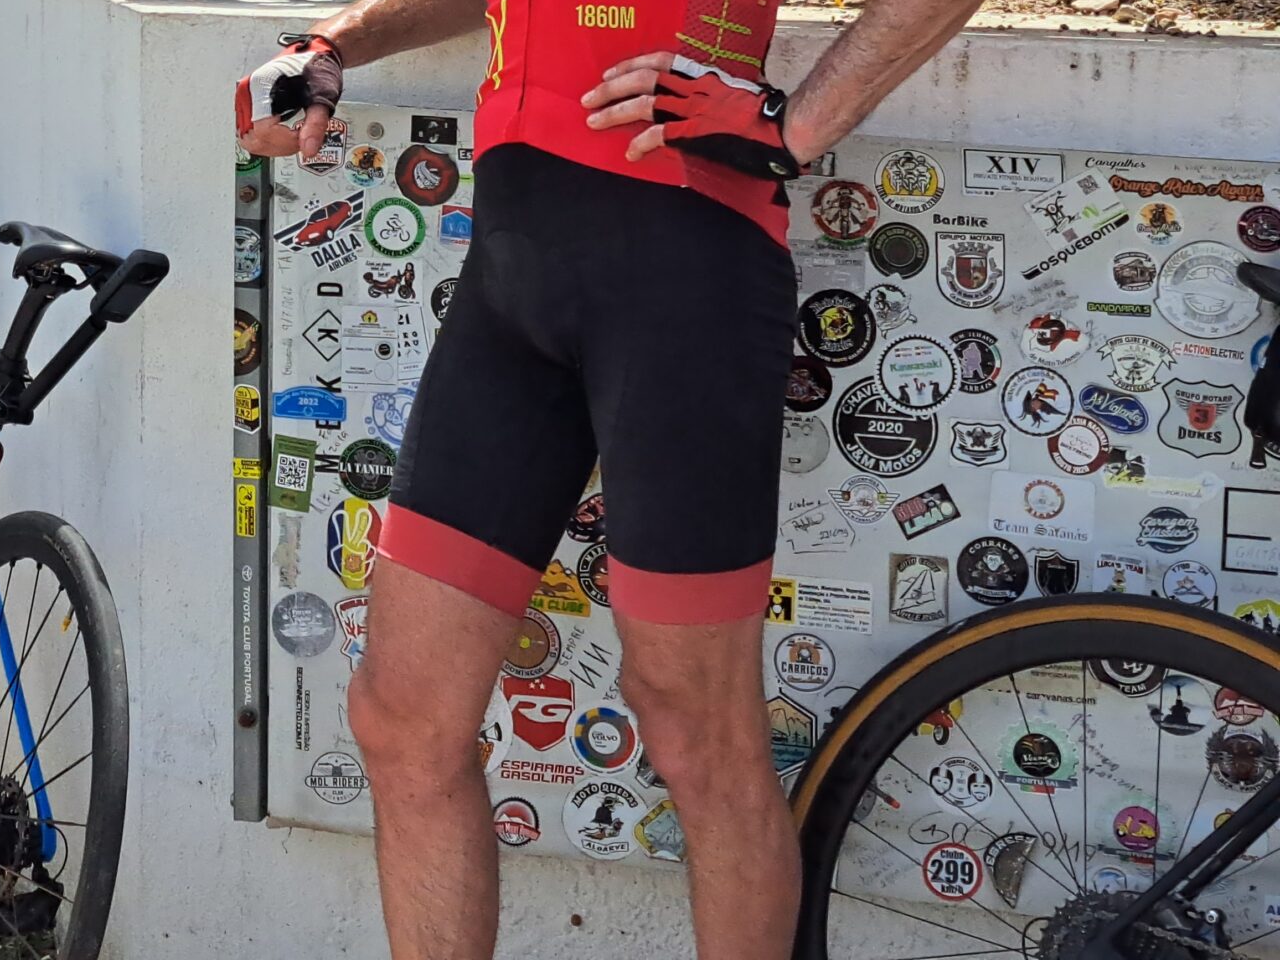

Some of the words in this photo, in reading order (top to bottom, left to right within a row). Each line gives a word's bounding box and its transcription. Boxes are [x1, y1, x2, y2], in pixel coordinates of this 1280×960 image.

[575, 4, 635, 29] 1860M
[987, 154, 1041, 175] XIV
[932, 213, 989, 228] BarBike
[310, 233, 362, 269] DALILA
[328, 252, 358, 273] AIRLINES
[1183, 343, 1245, 360] ACTIONELECTRIC
[889, 359, 943, 372] Kawasaki
[297, 397, 320, 406] 2022
[867, 420, 904, 435] 2020
[1177, 425, 1223, 444] DUKES
[845, 442, 876, 471] J&M
[878, 447, 923, 473] Motos
[993, 518, 1029, 534] Team
[968, 540, 1019, 562] CORRALES
[242, 585, 251, 622] TOYOTA
[243, 625, 252, 648] CLUB
[243, 651, 253, 706] PORTUGAL
[1118, 682, 1147, 694] TEAM
[500, 760, 585, 776] ESPIRAMOS
[500, 770, 576, 785] GASOLINA
[332, 777, 365, 788] RIDERS
[573, 784, 600, 808] MOTO
[930, 859, 974, 885] 299
